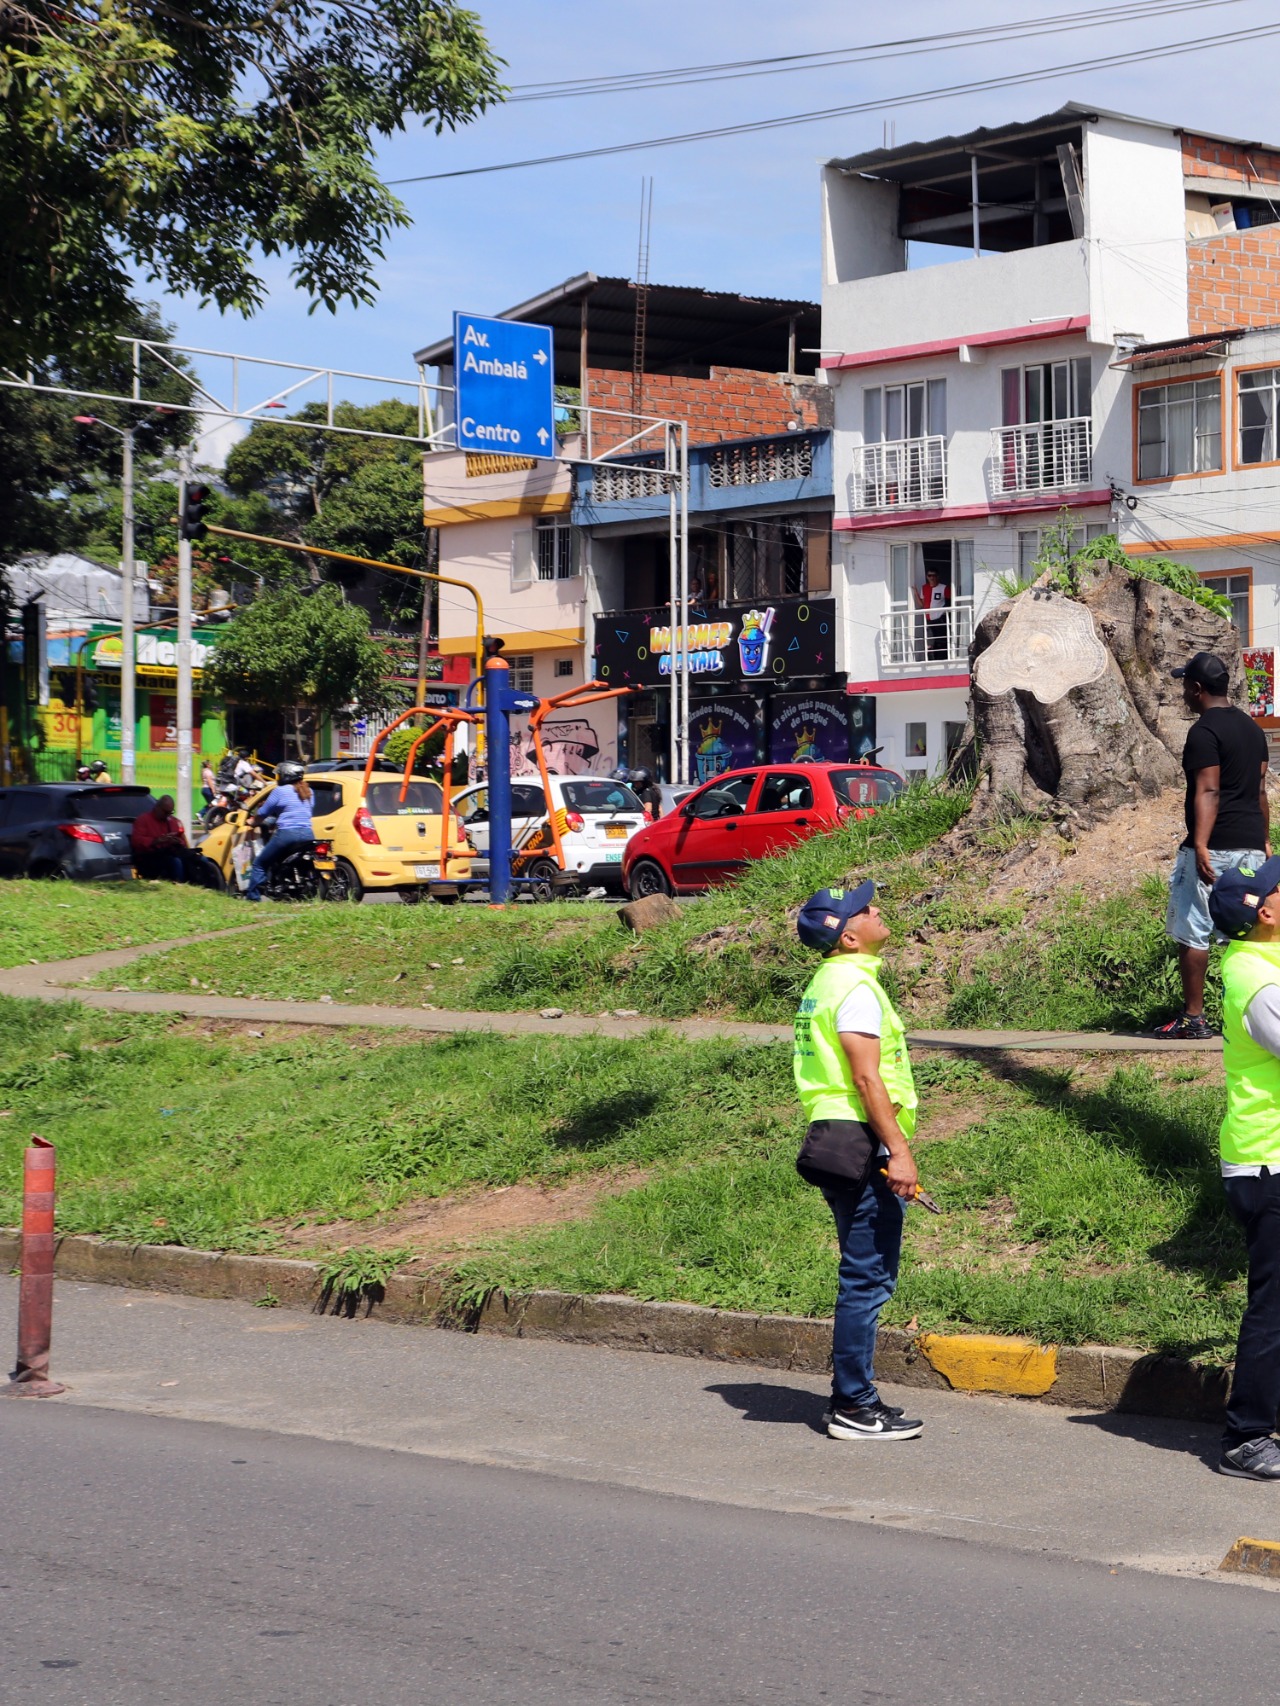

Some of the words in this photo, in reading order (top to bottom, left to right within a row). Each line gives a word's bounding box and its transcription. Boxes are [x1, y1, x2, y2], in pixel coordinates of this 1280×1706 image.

[463, 325, 490, 348] Av.
[463, 351, 528, 380] Ambalá
[461, 417, 521, 444] Centro
[733, 711, 750, 730] para
[780, 705, 797, 723] sitio
[814, 700, 848, 726] parchado
[790, 716, 801, 729] de
[605, 853, 623, 863] ENSE
